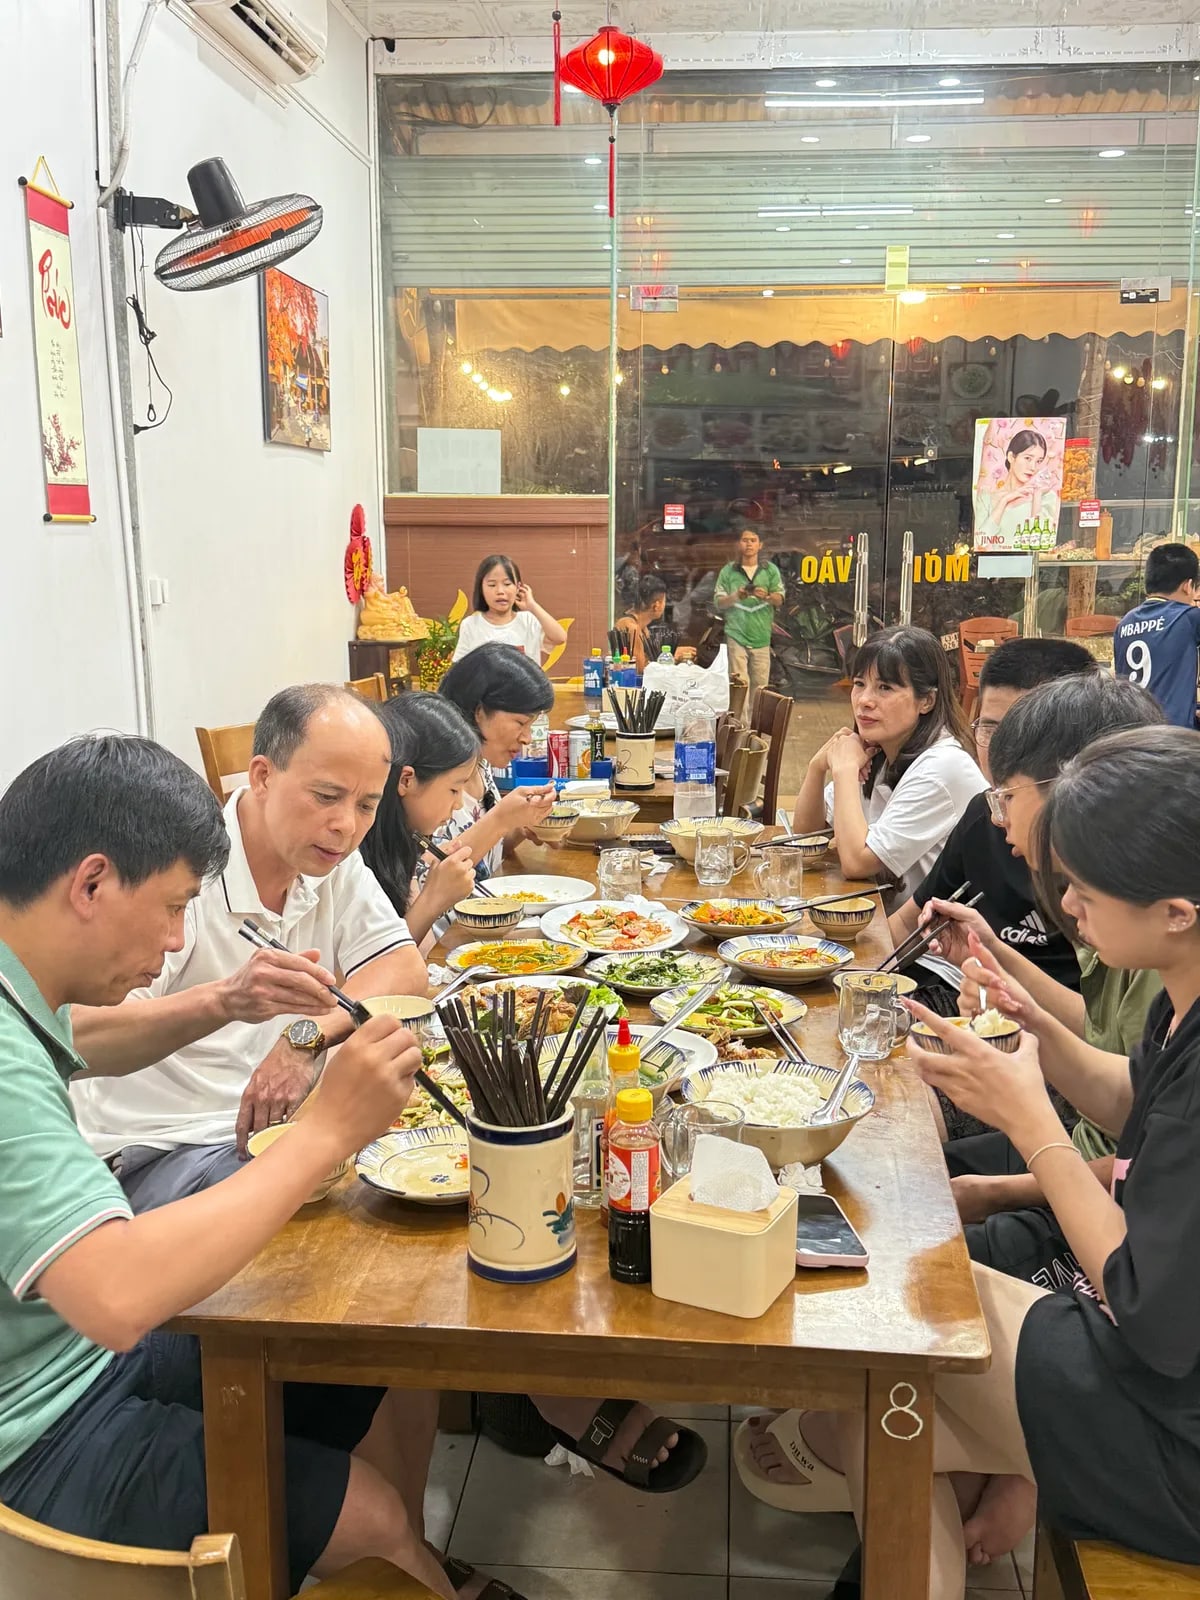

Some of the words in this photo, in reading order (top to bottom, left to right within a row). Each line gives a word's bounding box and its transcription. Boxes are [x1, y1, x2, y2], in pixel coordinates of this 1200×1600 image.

[981, 535, 1005, 545] JINRO
[1120, 615, 1165, 638] MBAPPÉ
[1126, 640, 1152, 689] 9
[881, 1382, 923, 1440] 8
